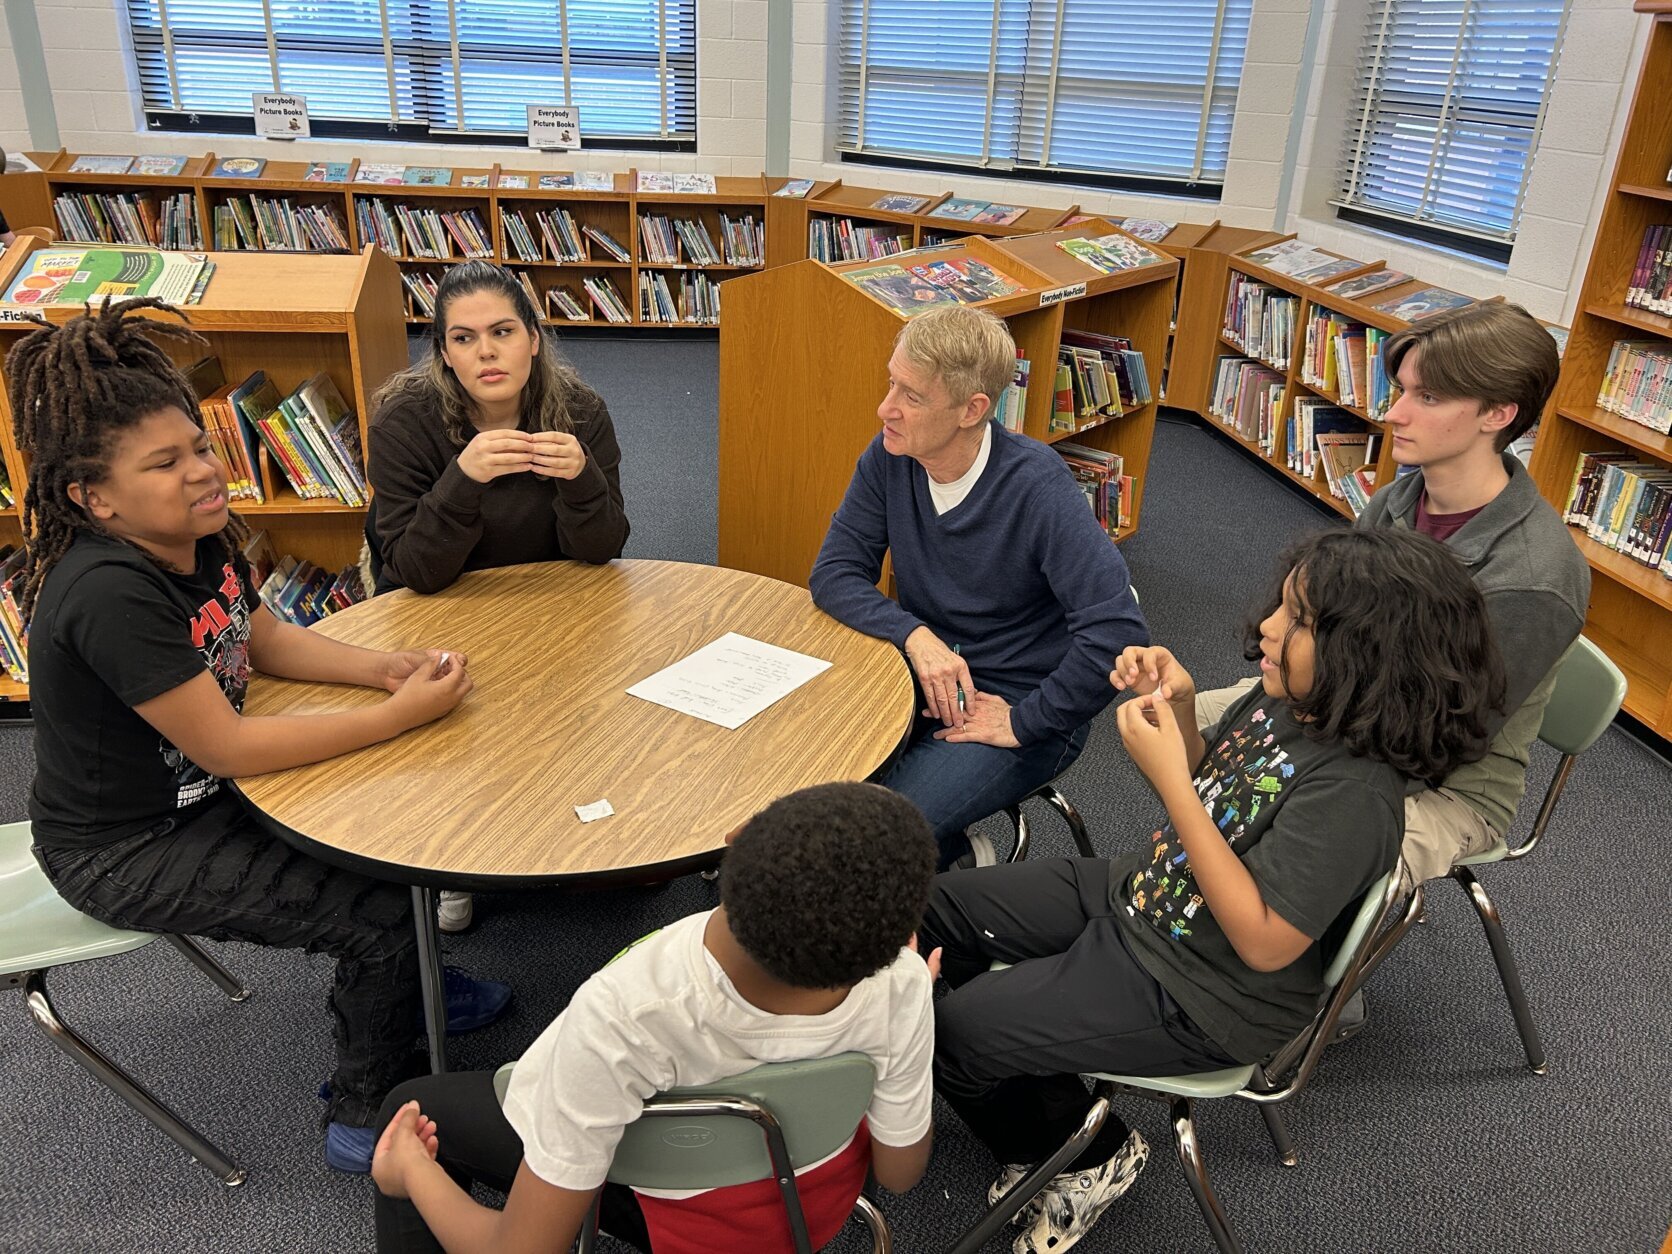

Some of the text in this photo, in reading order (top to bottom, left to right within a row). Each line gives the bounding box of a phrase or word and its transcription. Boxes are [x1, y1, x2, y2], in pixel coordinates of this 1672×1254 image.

[264, 96, 295, 105] Everybody
[259, 107, 303, 116] Picture Books
[538, 109, 569, 118] Everybody
[533, 119, 575, 128] Picture Books
[1041, 291, 1064, 304] Everybody
